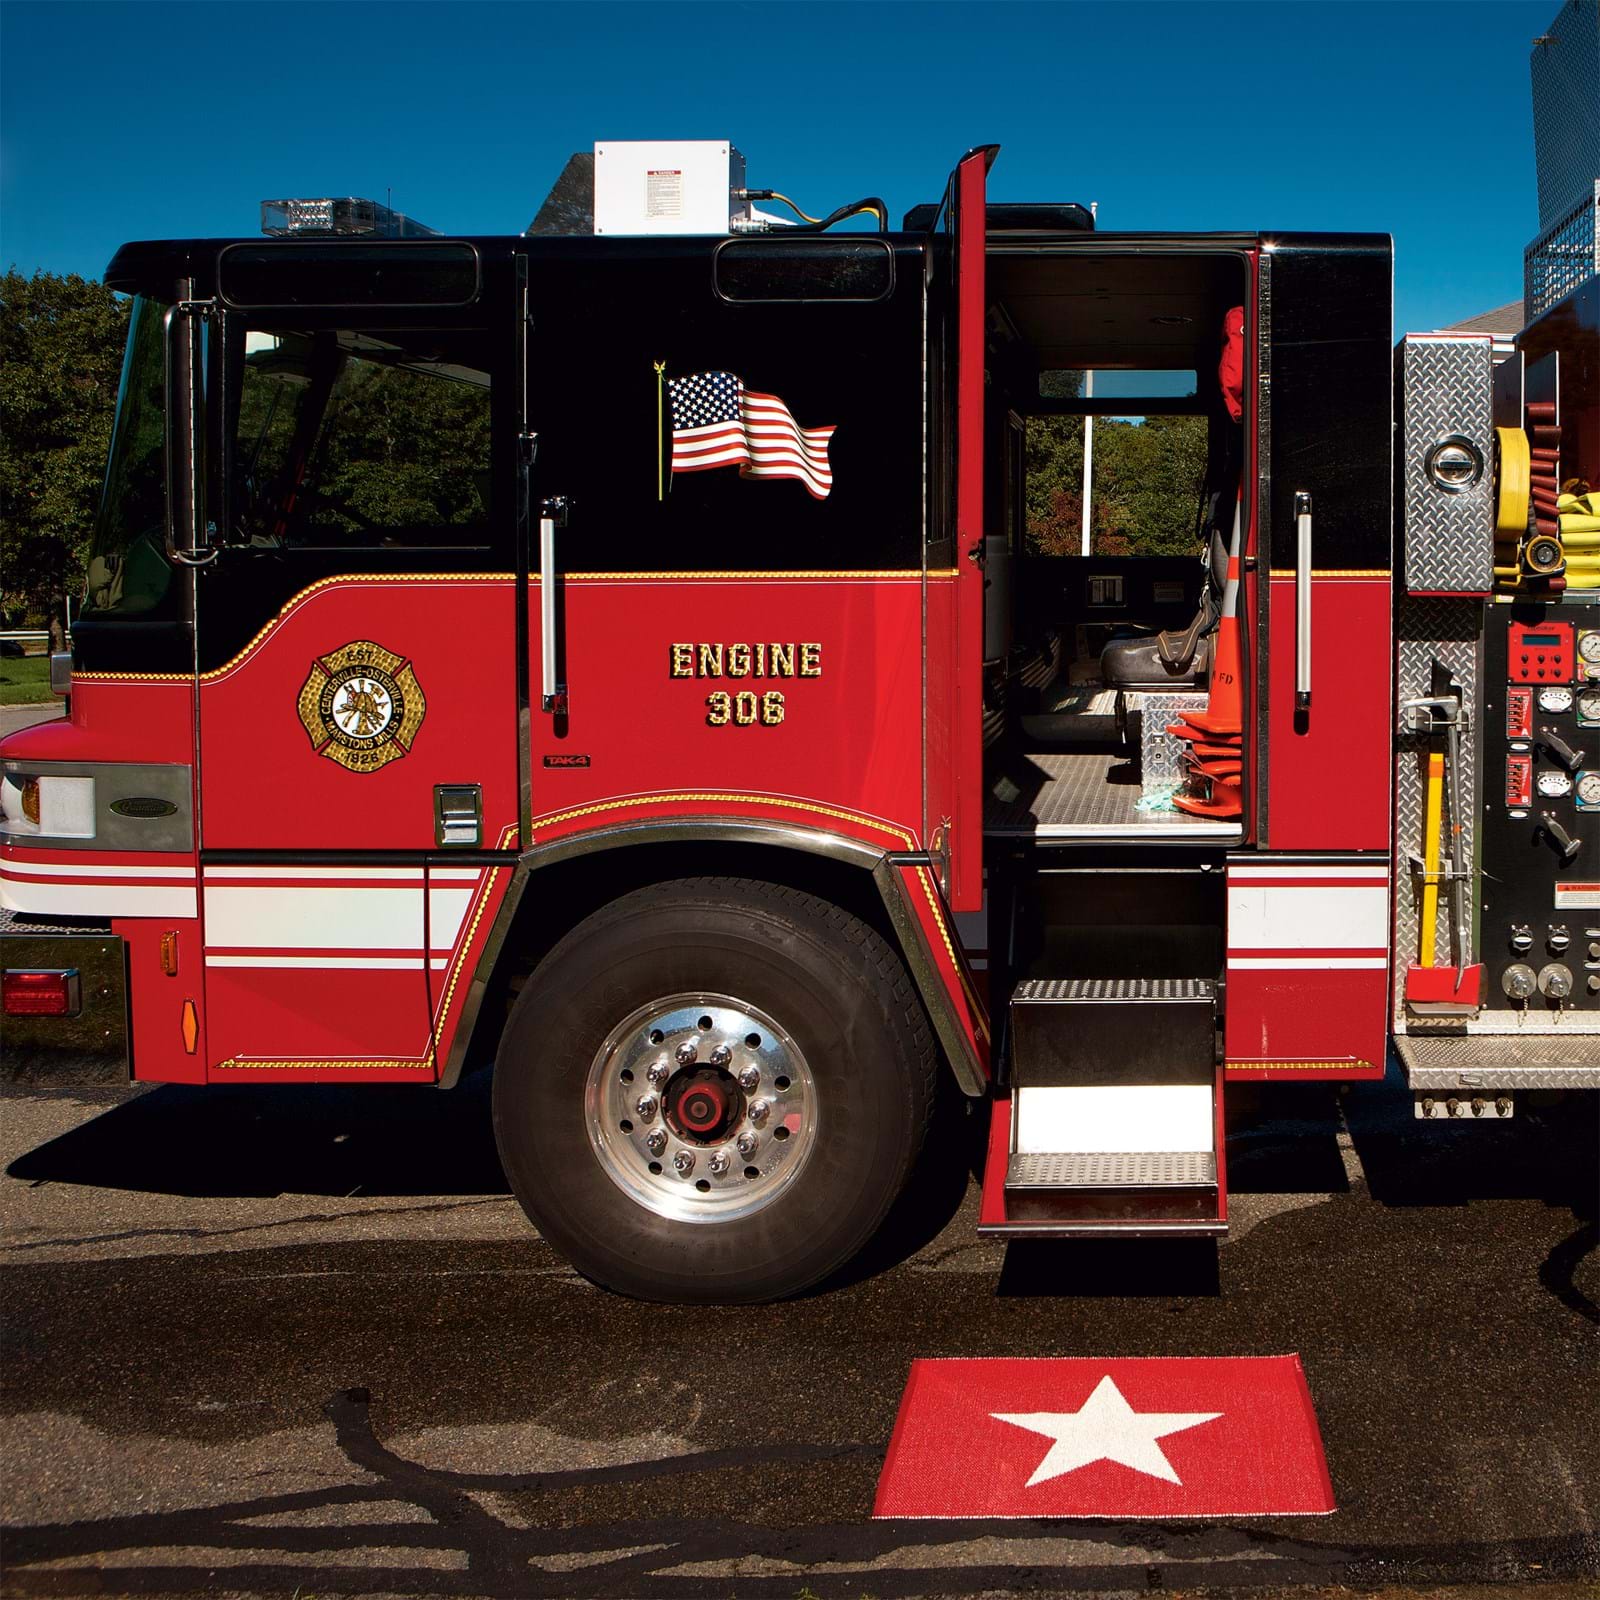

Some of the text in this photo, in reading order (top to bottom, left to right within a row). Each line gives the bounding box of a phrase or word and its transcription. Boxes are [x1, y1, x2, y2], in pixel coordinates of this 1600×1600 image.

[347, 650, 374, 661] EST
[670, 643, 822, 679] ENGINE
[706, 691, 785, 727] 306
[325, 719, 400, 750] MARSTONS MILLS
[346, 752, 380, 765] 1926
